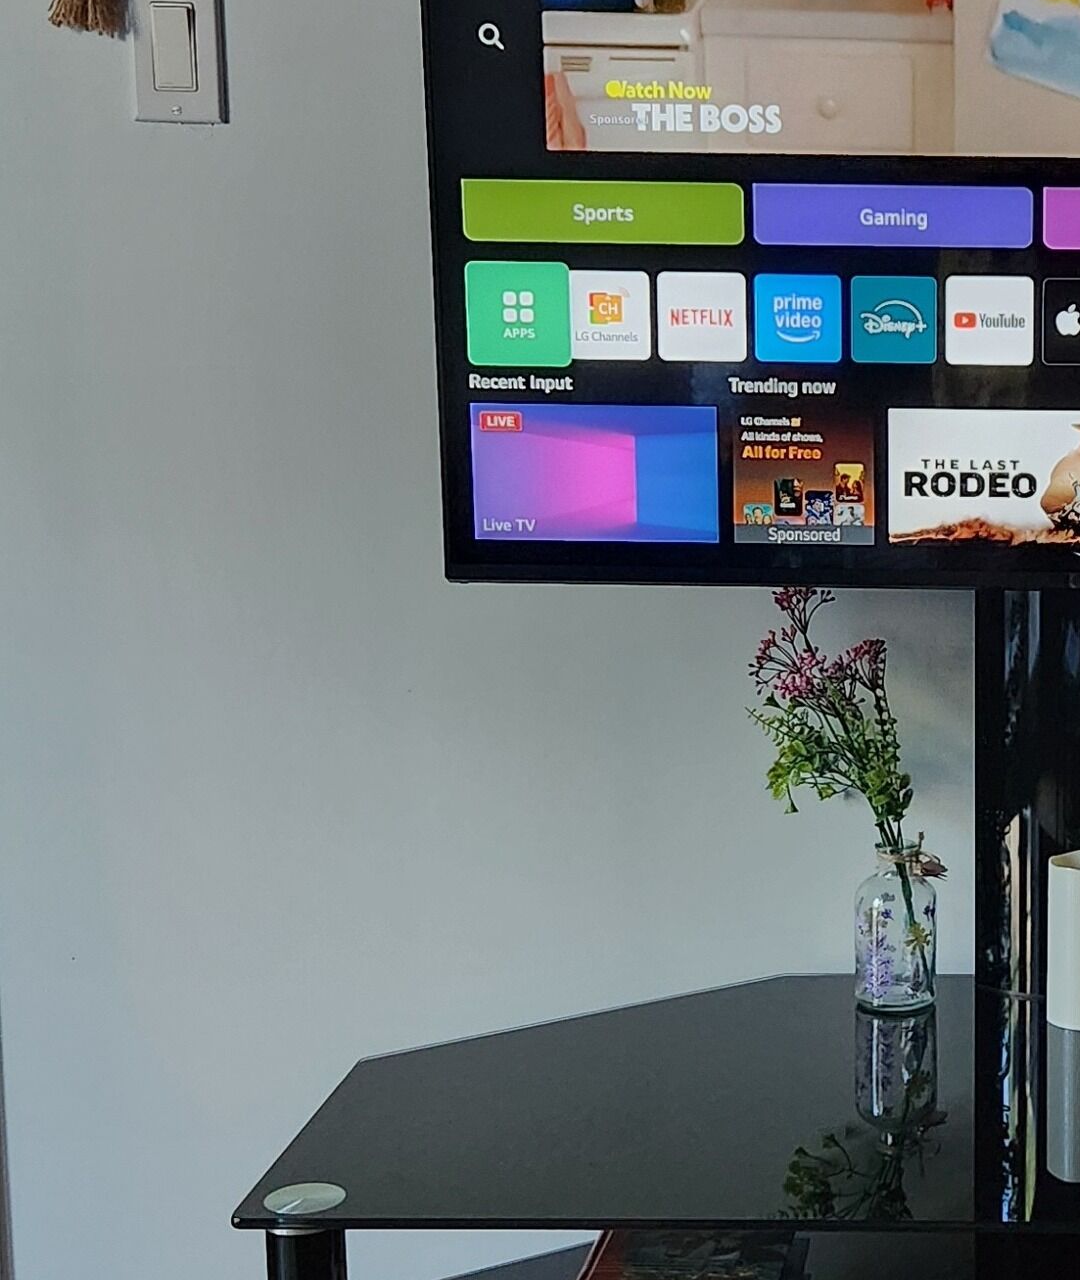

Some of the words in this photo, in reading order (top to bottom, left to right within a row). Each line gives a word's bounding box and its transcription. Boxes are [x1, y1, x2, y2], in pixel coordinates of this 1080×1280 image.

[668, 81, 712, 99] Now
[632, 103, 693, 132] THE
[700, 104, 782, 133] BOSS
[573, 204, 634, 224] Sports
[860, 208, 928, 230] Gaming
[598, 301, 618, 314] CH
[773, 293, 823, 312] prime
[669, 308, 734, 327] NETFLIX
[774, 311, 822, 329] video
[978, 312, 1026, 328] YouTube
[503, 327, 536, 338] APPS
[575, 331, 589, 342] LG
[591, 331, 639, 343] Channels
[468, 374, 526, 390] Recent
[530, 375, 574, 393] Input
[728, 377, 798, 397] Trending
[802, 382, 836, 394] now
[486, 415, 515, 427] LIVE
[742, 445, 763, 459] All
[764, 445, 786, 459] for
[788, 446, 821, 459] Free
[920, 458, 959, 469] THE
[969, 459, 1020, 470] LAST
[904, 471, 1037, 498] RODEO
[483, 518, 512, 532] Live
[515, 518, 536, 532] TV
[768, 526, 841, 543] Sponsored
